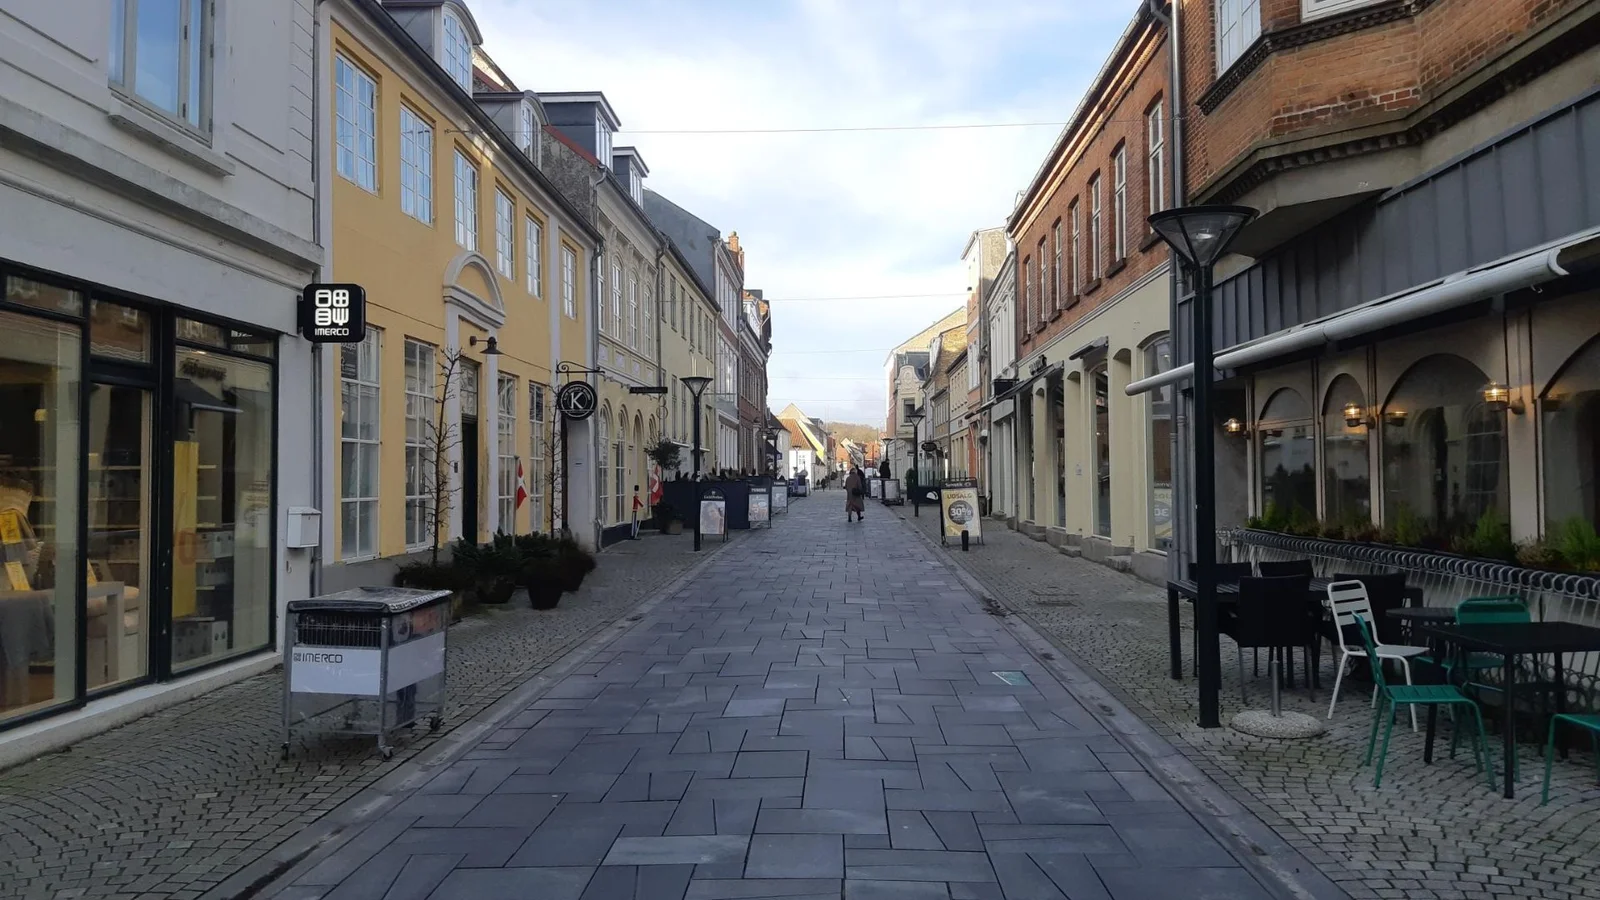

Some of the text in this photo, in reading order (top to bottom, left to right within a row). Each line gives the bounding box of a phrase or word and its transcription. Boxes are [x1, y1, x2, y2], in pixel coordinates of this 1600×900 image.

[314, 328, 350, 336] IMERCO
[570, 391, 584, 409] K
[951, 508, 972, 516] 30%
[302, 652, 343, 663] IMERCO
